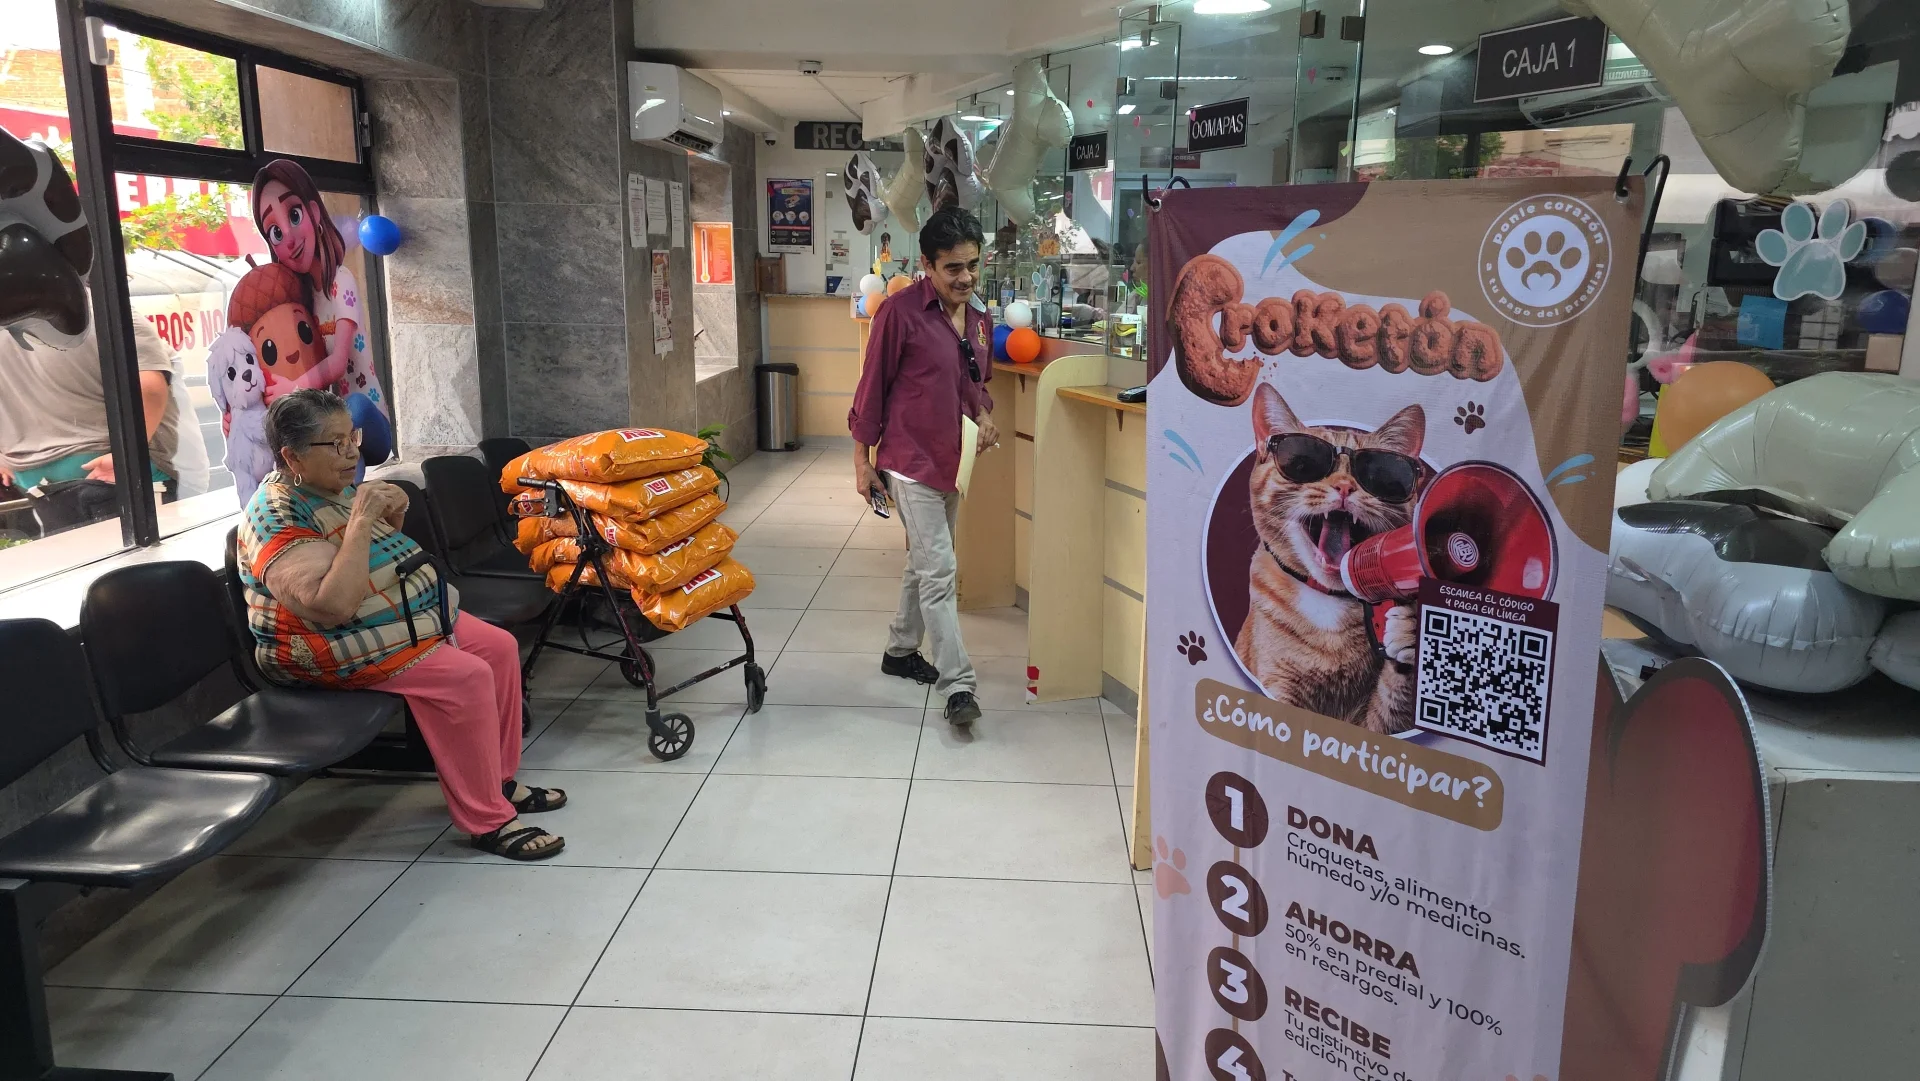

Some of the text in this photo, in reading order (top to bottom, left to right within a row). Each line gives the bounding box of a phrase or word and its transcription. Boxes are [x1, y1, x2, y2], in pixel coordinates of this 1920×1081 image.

[1502, 38, 1576, 78] CAJA 1
[1192, 113, 1244, 139] OOMAPAS
[1076, 143, 1100, 160] CAJA 2
[1493, 201, 1604, 244] ponle corazón
[1486, 262, 1604, 318] a tu pago del predial
[1439, 584, 1534, 612] ESCANEA EL CÓDIGO
[1454, 599, 1479, 612] PAGA
[1481, 604, 1494, 616] EN
[1496, 606, 1526, 623] LÍNEA
[1203, 694, 1492, 808] ¿Cómo participar?
[1224, 785, 1244, 832] 1
[1287, 805, 1379, 861] DONA
[1220, 874, 1250, 923] 2
[1287, 832, 1492, 925] Croquetas, alimento
[1287, 846, 1526, 958] húmedo y/o medicinas.
[1285, 901, 1421, 979] AHORRA
[1219, 959, 1249, 1004] 3
[1285, 942, 1399, 1006] en recargos.
[1285, 923, 1503, 1036] 50% en predial y 100%
[1284, 1009, 1304, 1032] Tu
[1308, 1025, 1389, 1076] distintivo
[1285, 986, 1391, 1059] RECIBE
[1217, 1045, 1250, 1081] 4
[1285, 1029, 1348, 1072] edición
